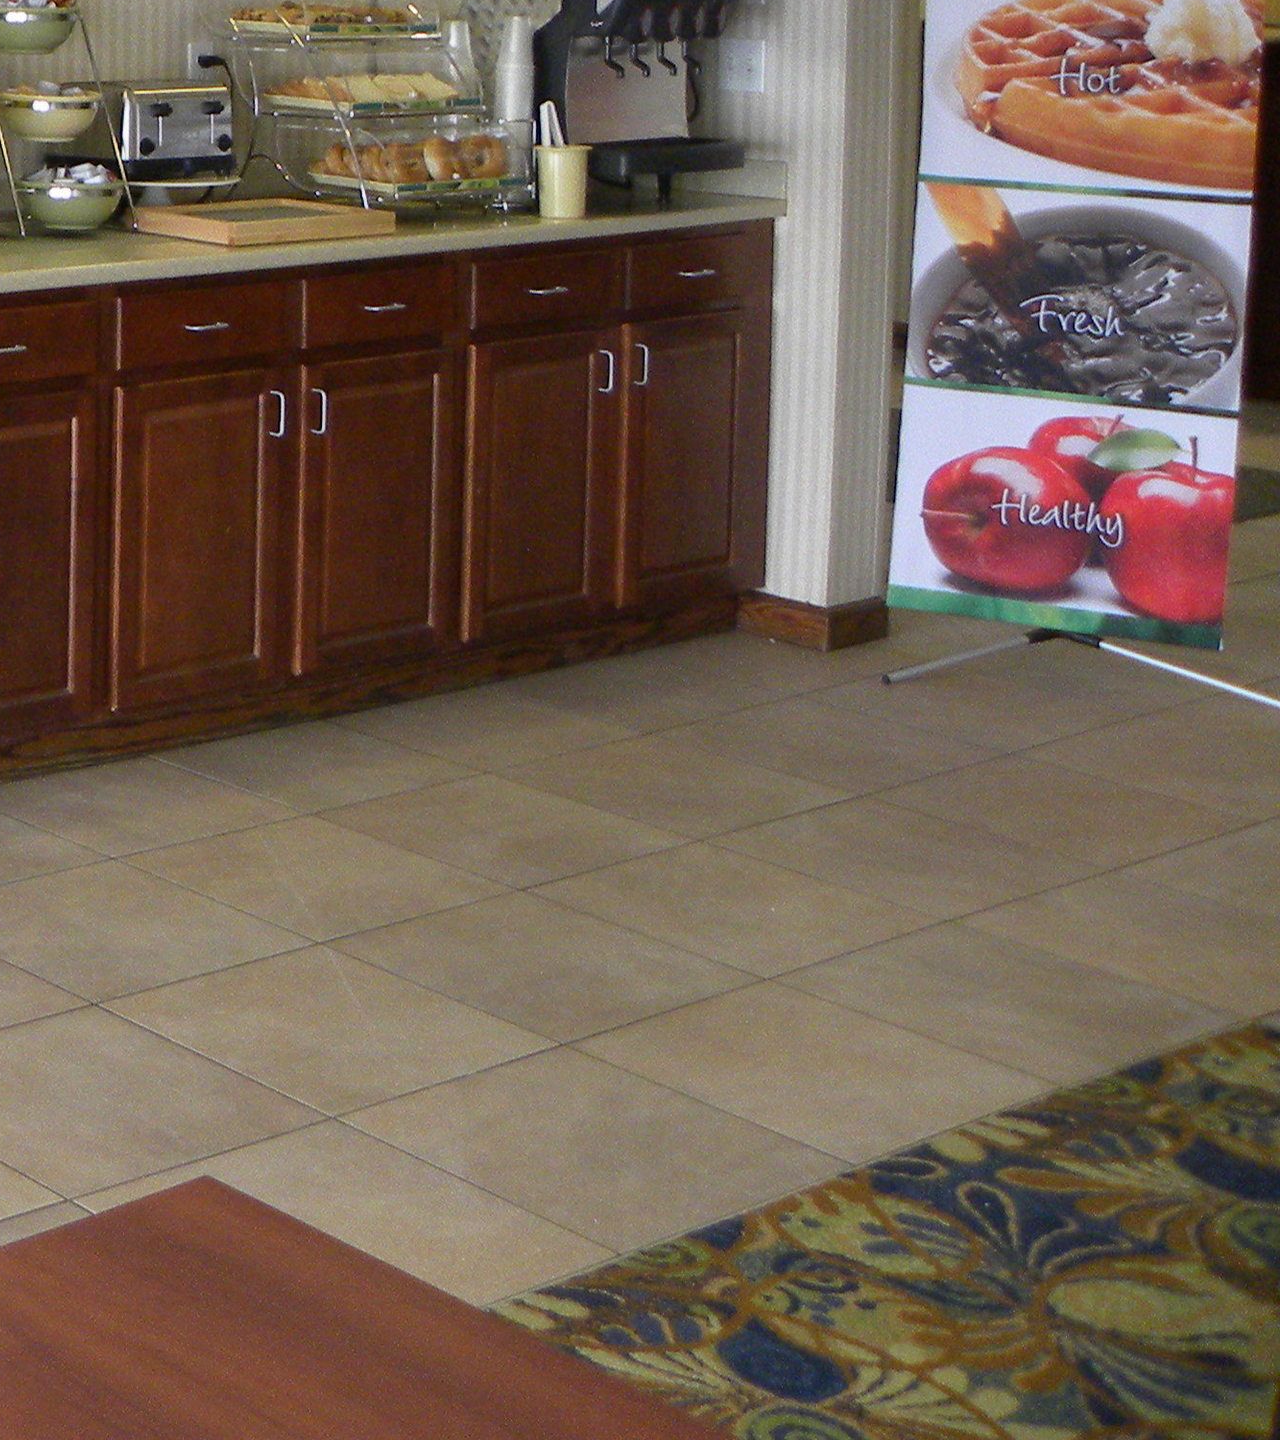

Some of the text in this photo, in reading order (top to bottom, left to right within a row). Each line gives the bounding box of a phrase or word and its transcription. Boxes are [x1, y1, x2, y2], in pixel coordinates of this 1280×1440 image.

[1050, 58, 1122, 98] Hot
[1020, 295, 1125, 337] Fresh
[991, 488, 1124, 547] Healthy
